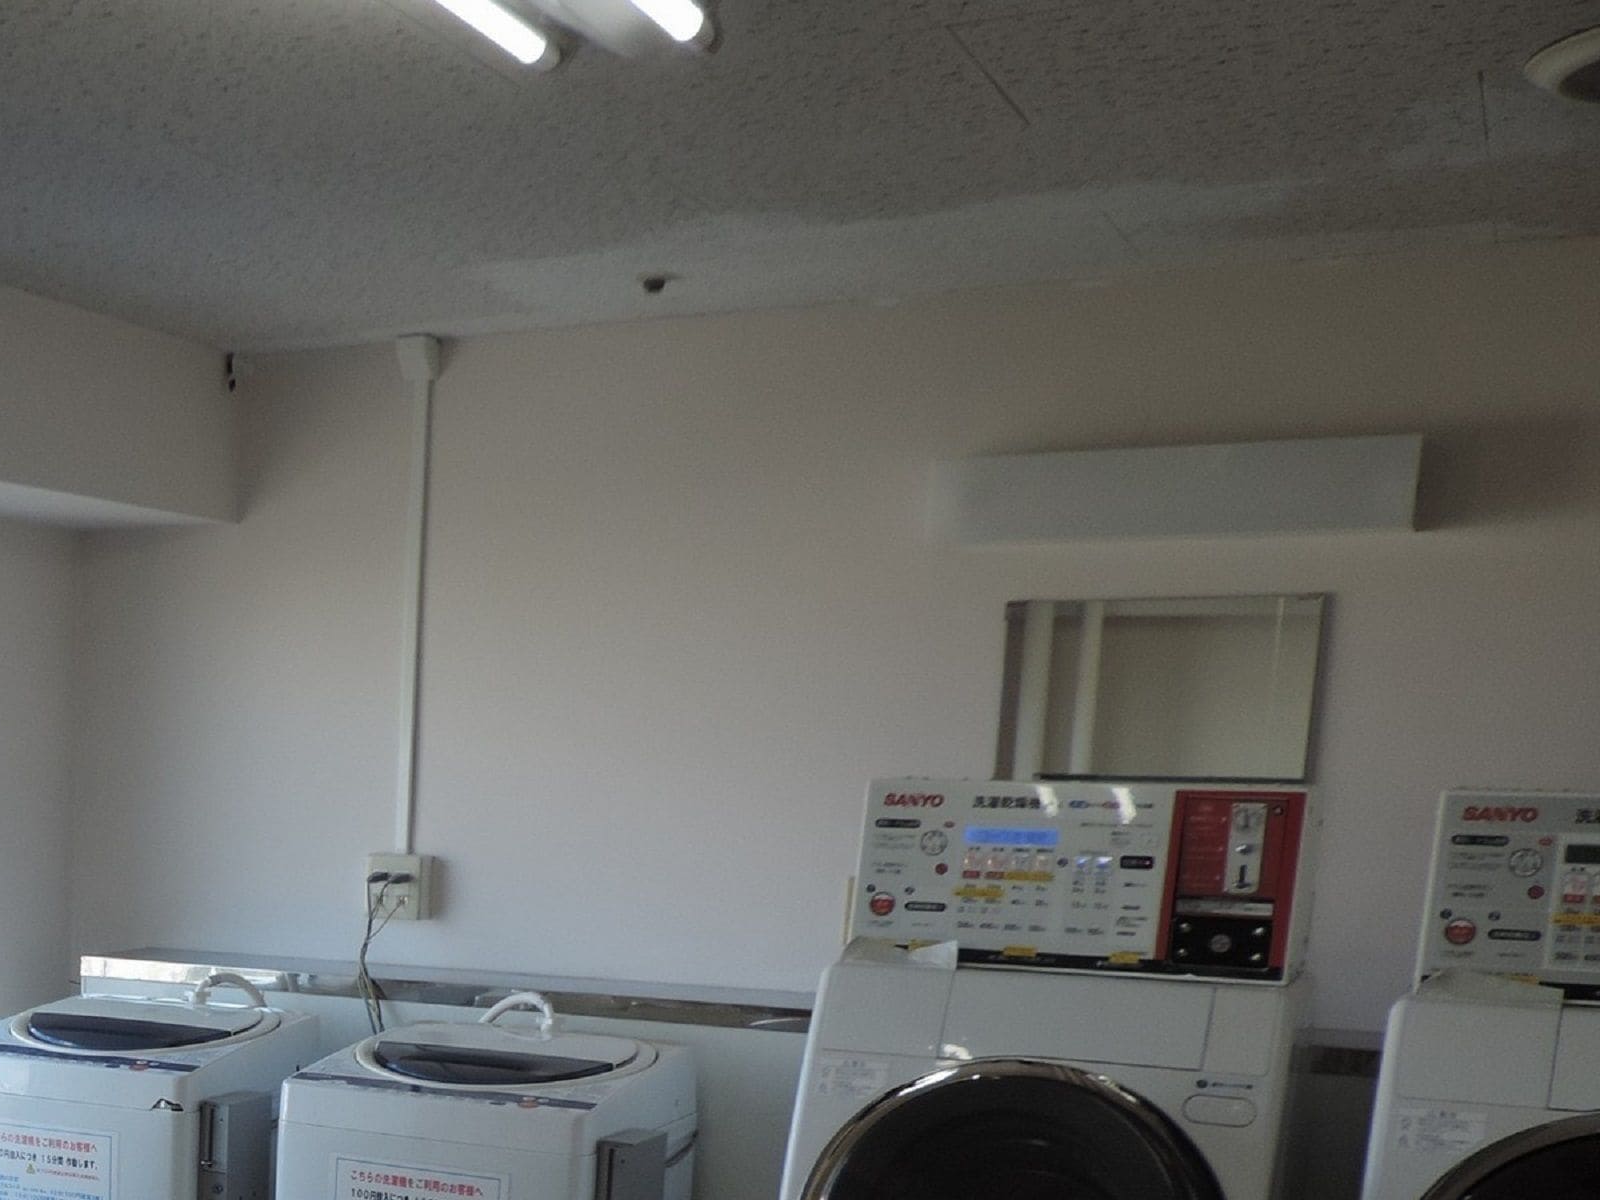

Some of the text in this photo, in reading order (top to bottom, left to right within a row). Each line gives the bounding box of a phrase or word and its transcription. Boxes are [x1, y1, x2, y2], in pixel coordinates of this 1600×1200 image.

[883, 793, 946, 808] SANYO
[1462, 805, 1539, 823] SANYO
[350, 1170, 483, 1196] こちらの洗濯機をご利用のお客様へ
